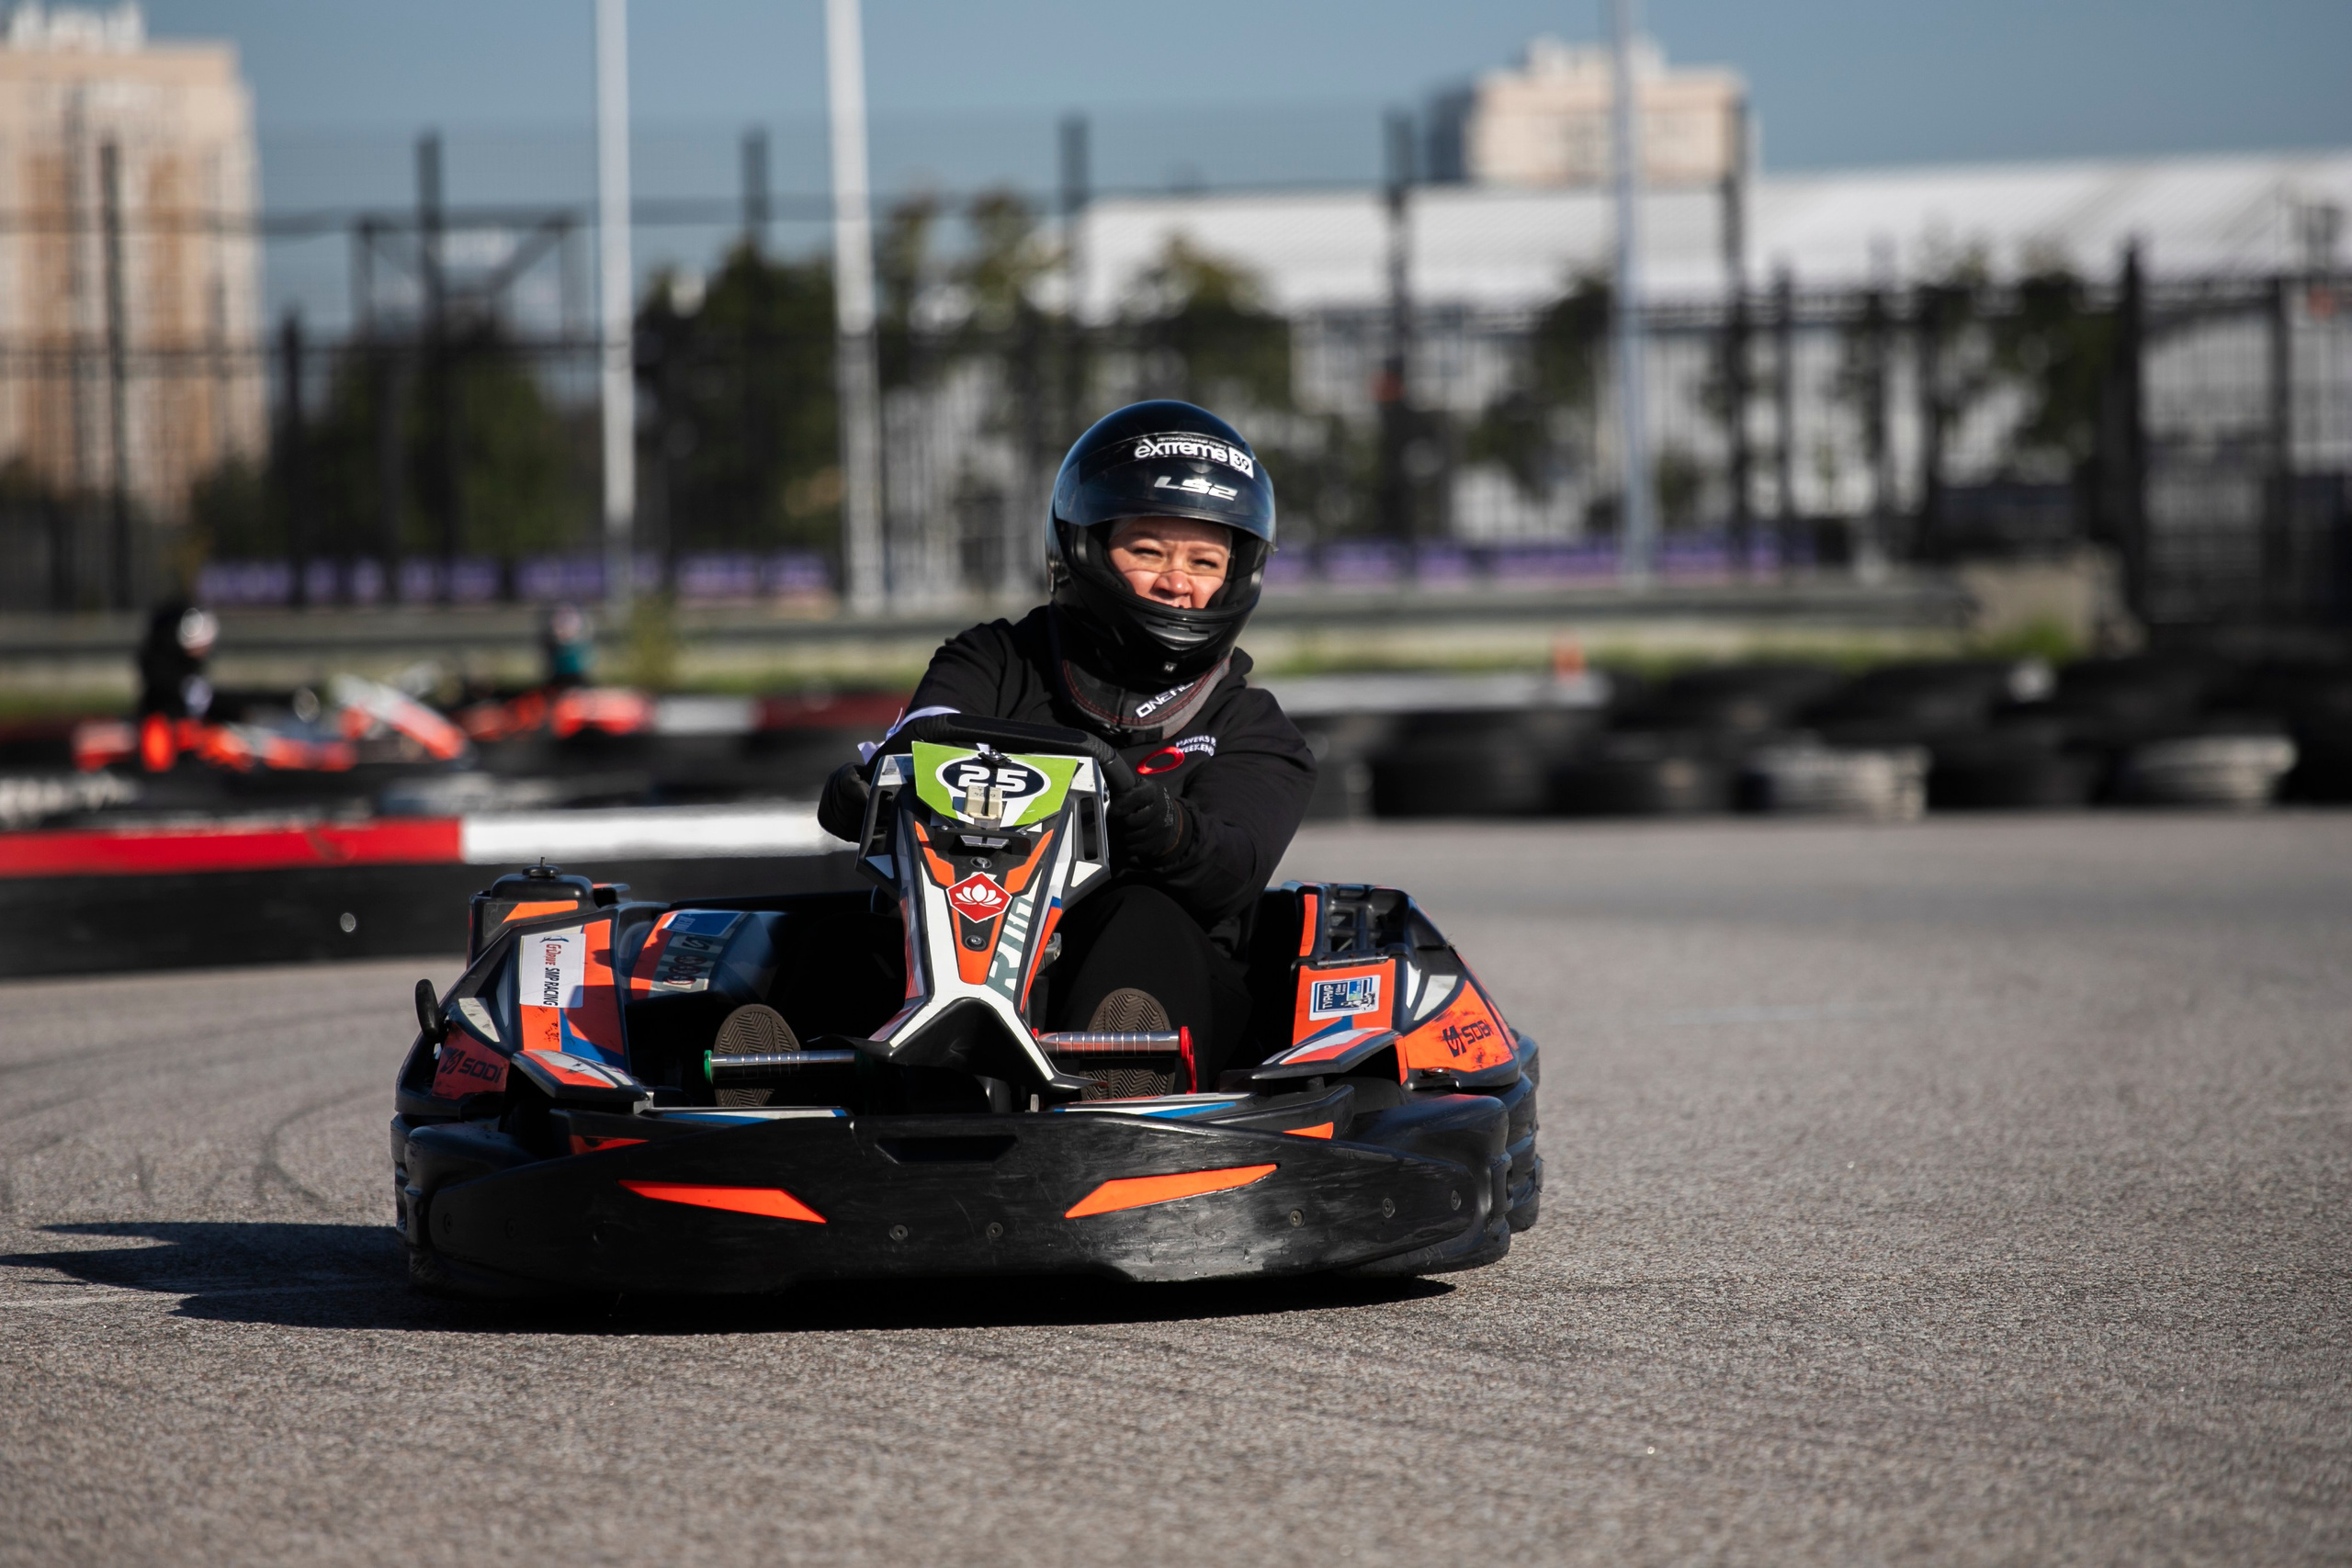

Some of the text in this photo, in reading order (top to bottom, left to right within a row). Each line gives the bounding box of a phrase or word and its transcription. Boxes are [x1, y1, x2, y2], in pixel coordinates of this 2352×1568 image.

[1154, 476, 1238, 502] LS2
[957, 763, 1028, 793] 25
[544, 967, 560, 982] SMP
[543, 981, 560, 1006] RACING
[1322, 985, 1334, 1010] ТУРНИР
[458, 1057, 504, 1084] SODI
